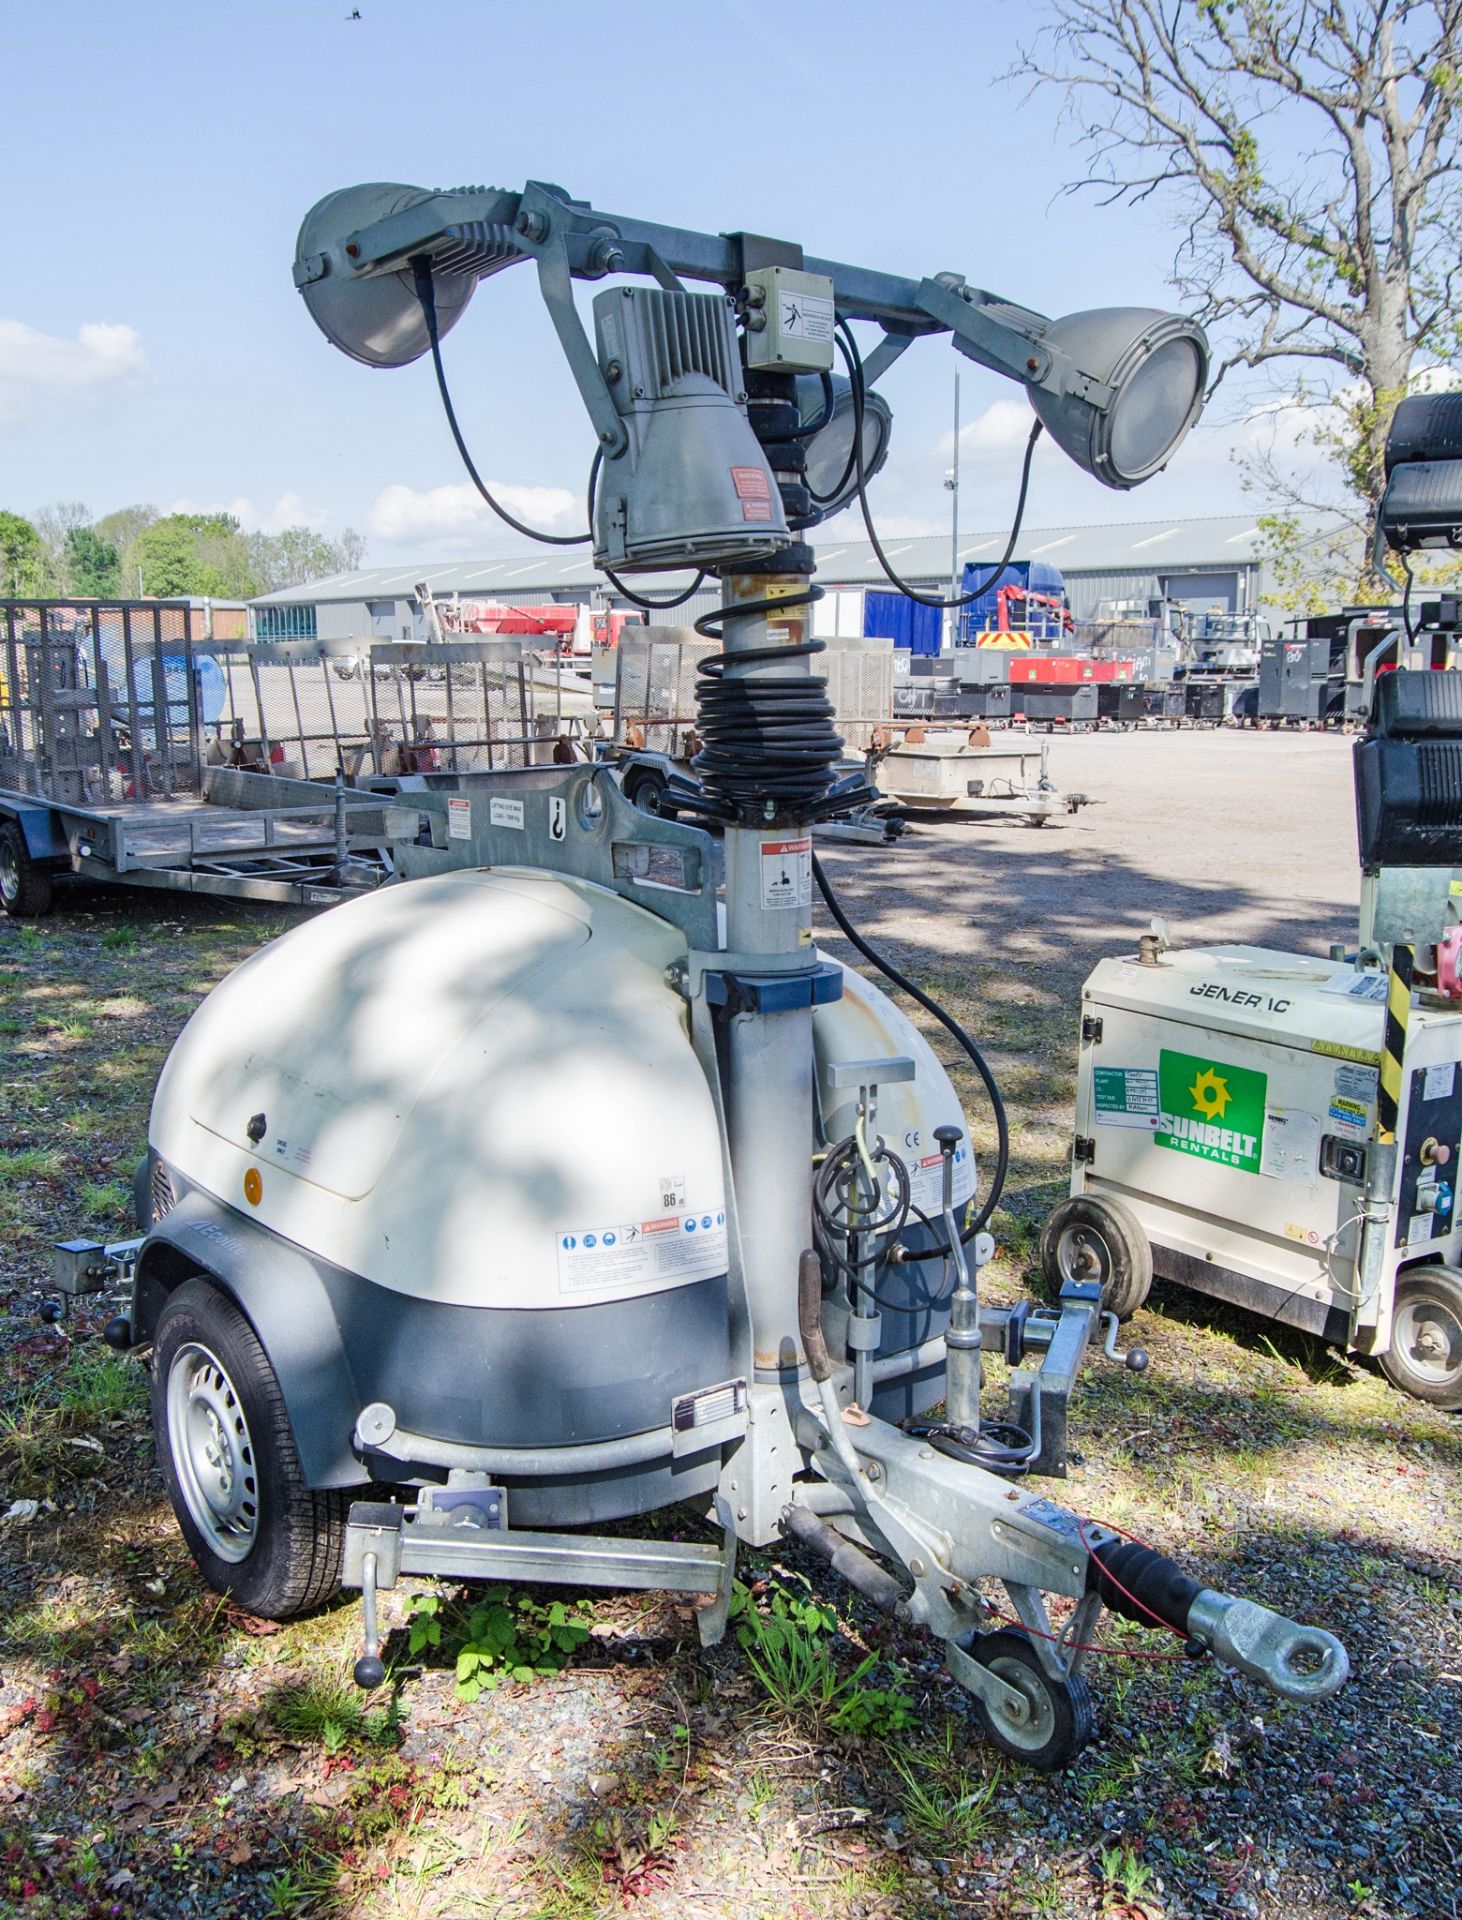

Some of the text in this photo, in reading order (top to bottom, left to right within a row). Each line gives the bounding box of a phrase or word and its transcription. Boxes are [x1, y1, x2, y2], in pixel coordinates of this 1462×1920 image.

[905, 1131, 920, 1148] CE
[1159, 1111, 1257, 1158] SUNBELT
[1170, 1137, 1240, 1166] RENTALS
[663, 1192, 676, 1207] 86
